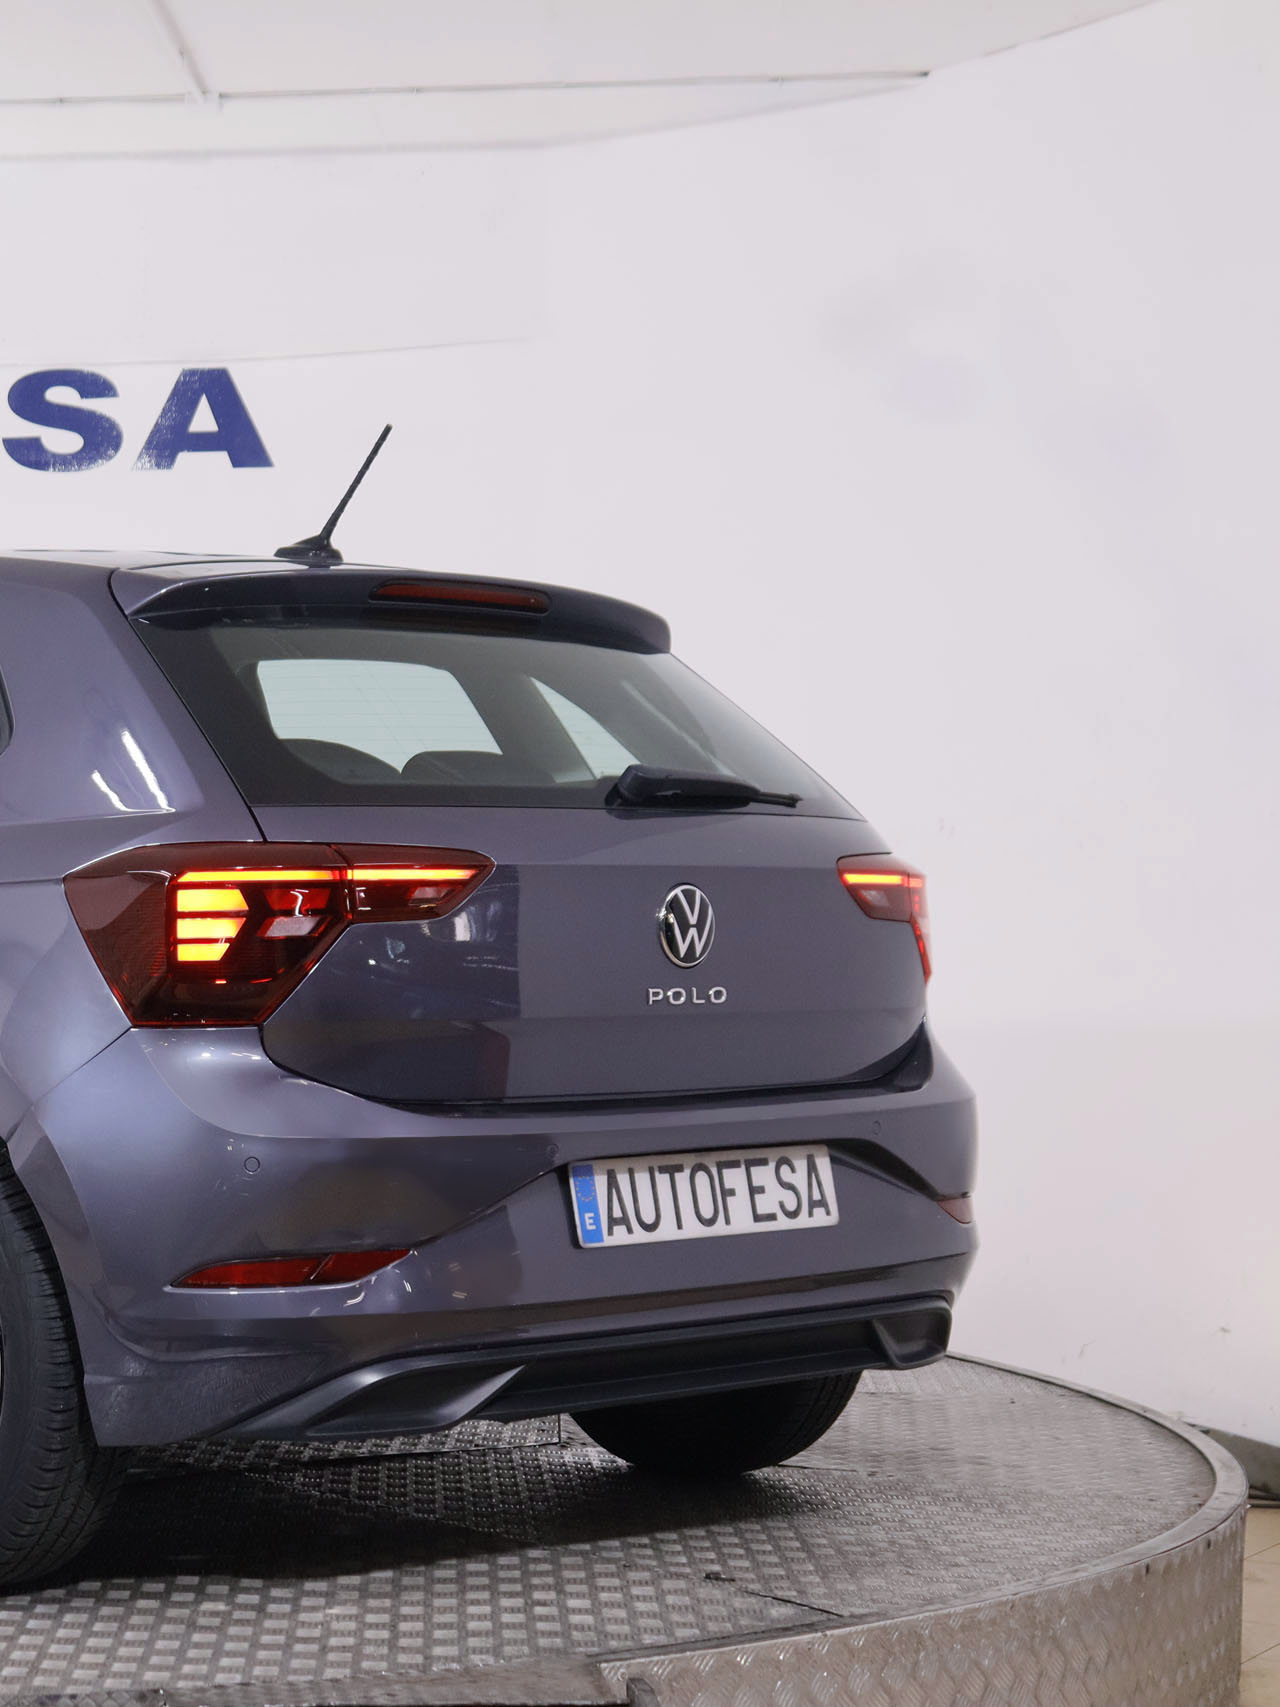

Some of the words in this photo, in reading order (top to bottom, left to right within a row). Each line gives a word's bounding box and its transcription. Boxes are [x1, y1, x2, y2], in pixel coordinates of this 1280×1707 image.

[665, 886, 715, 960] VW
[647, 986, 727, 1005] POLO
[584, 1213, 596, 1230] E
[606, 1153, 831, 1236] AUTOFESA
